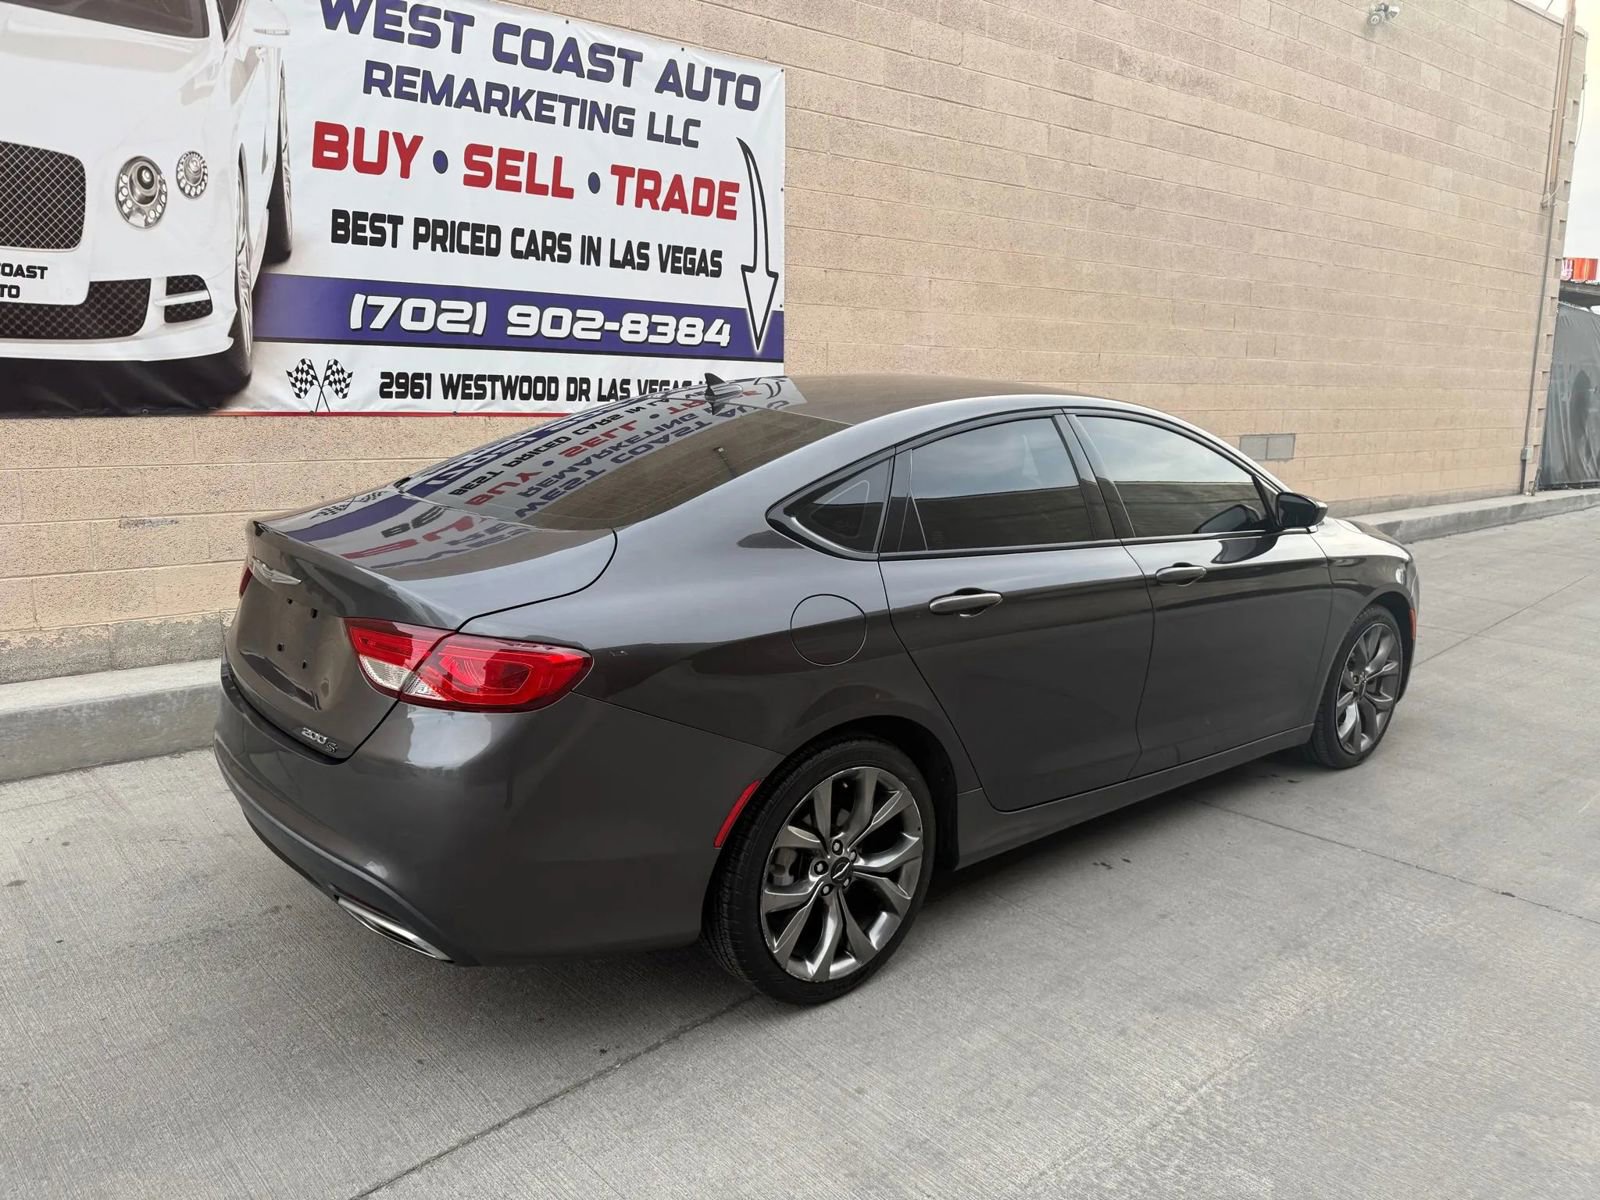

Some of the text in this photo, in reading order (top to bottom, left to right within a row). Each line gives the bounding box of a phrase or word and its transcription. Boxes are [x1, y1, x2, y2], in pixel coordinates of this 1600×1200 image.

[320, 0, 762, 112] WEST COAST AUTO
[362, 59, 701, 149] REMARKETING LLC
[311, 120, 740, 221] BUY SELL TRADE
[0, 262, 48, 279] OAST
[330, 208, 723, 279] BEST PRICED CARS IN LAS VEGAS
[350, 293, 731, 347] (702) 902-8384
[378, 371, 433, 400] 2961
[439, 373, 560, 402] WESTWOOD
[565, 376, 591, 402] DR
[596, 377, 631, 402] LAS
